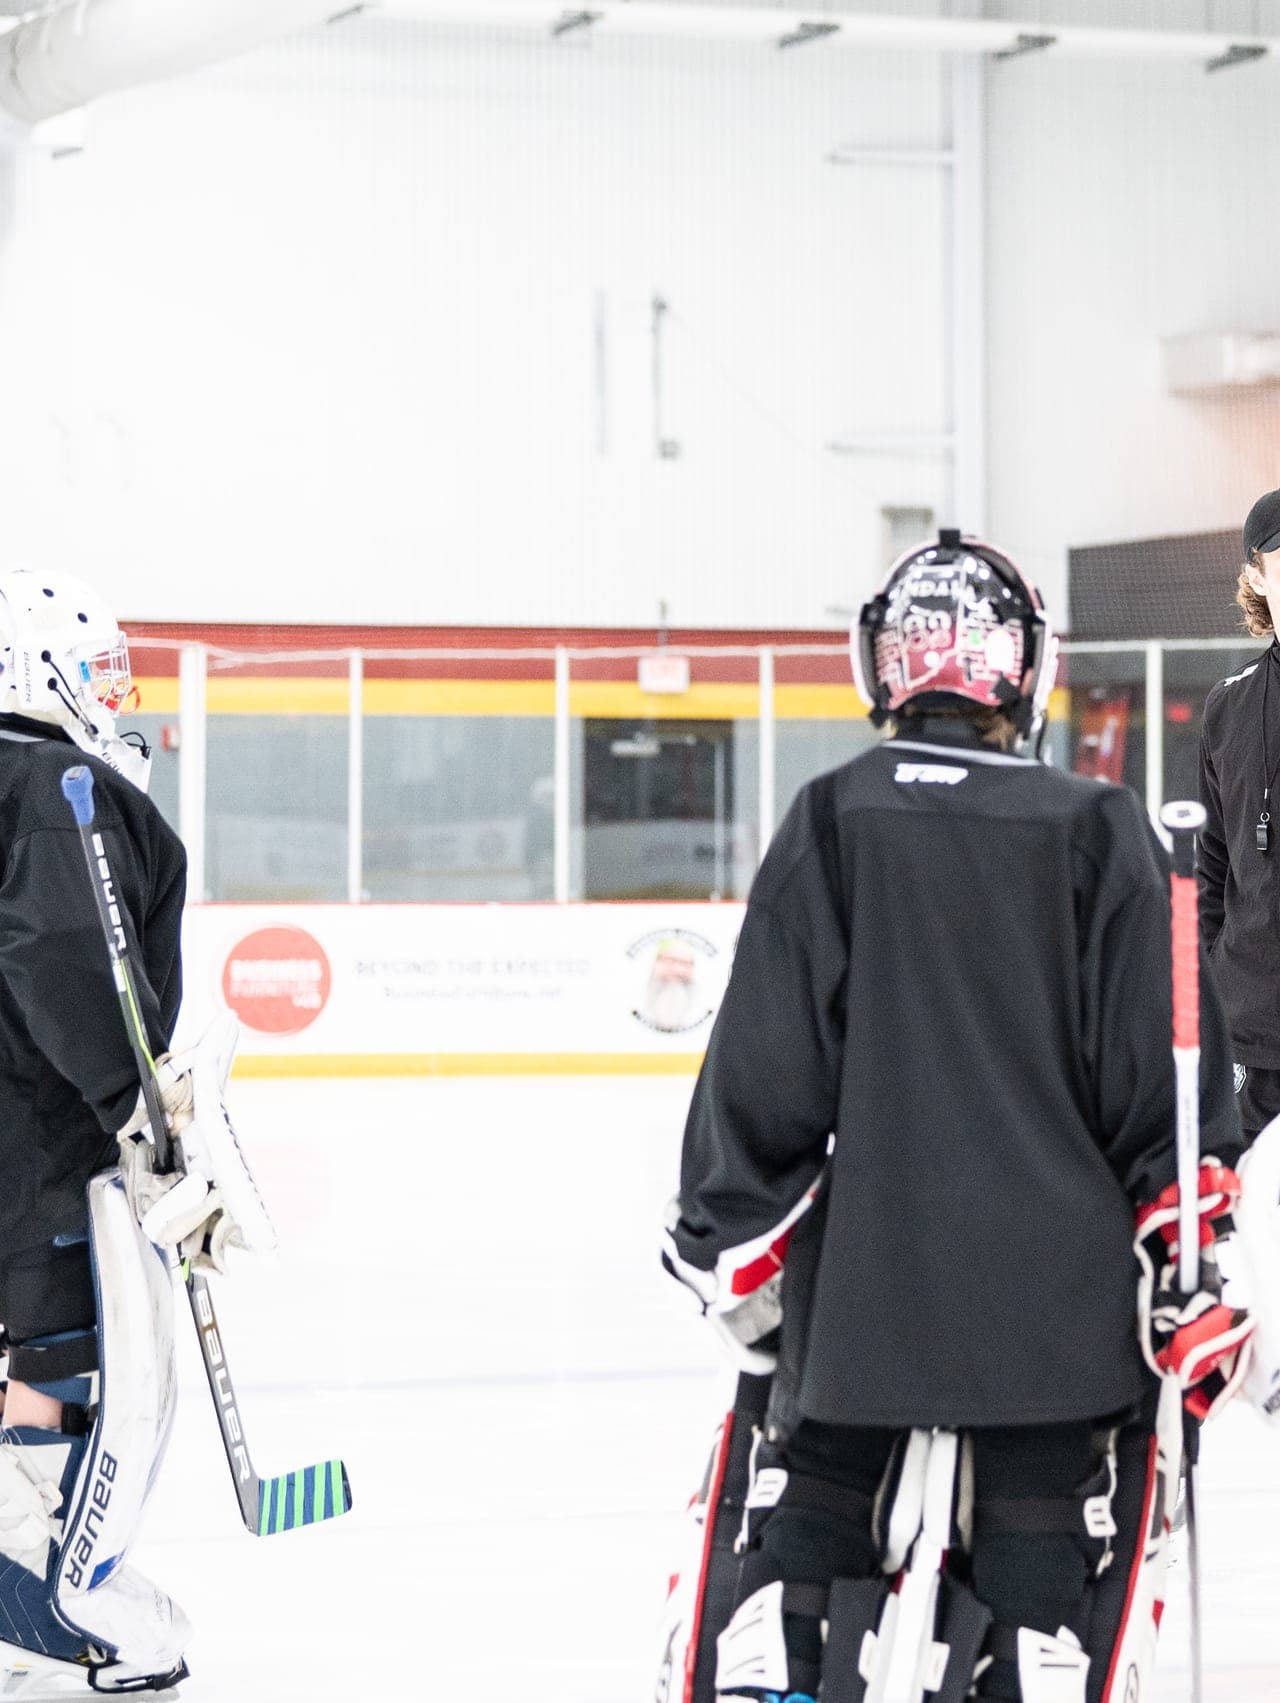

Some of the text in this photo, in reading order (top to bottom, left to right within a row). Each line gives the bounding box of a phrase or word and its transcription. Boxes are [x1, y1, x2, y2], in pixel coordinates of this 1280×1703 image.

[91, 832, 127, 951] BAUER
[196, 1288, 250, 1481] BAUER
[64, 1448, 118, 1589] BAUER
